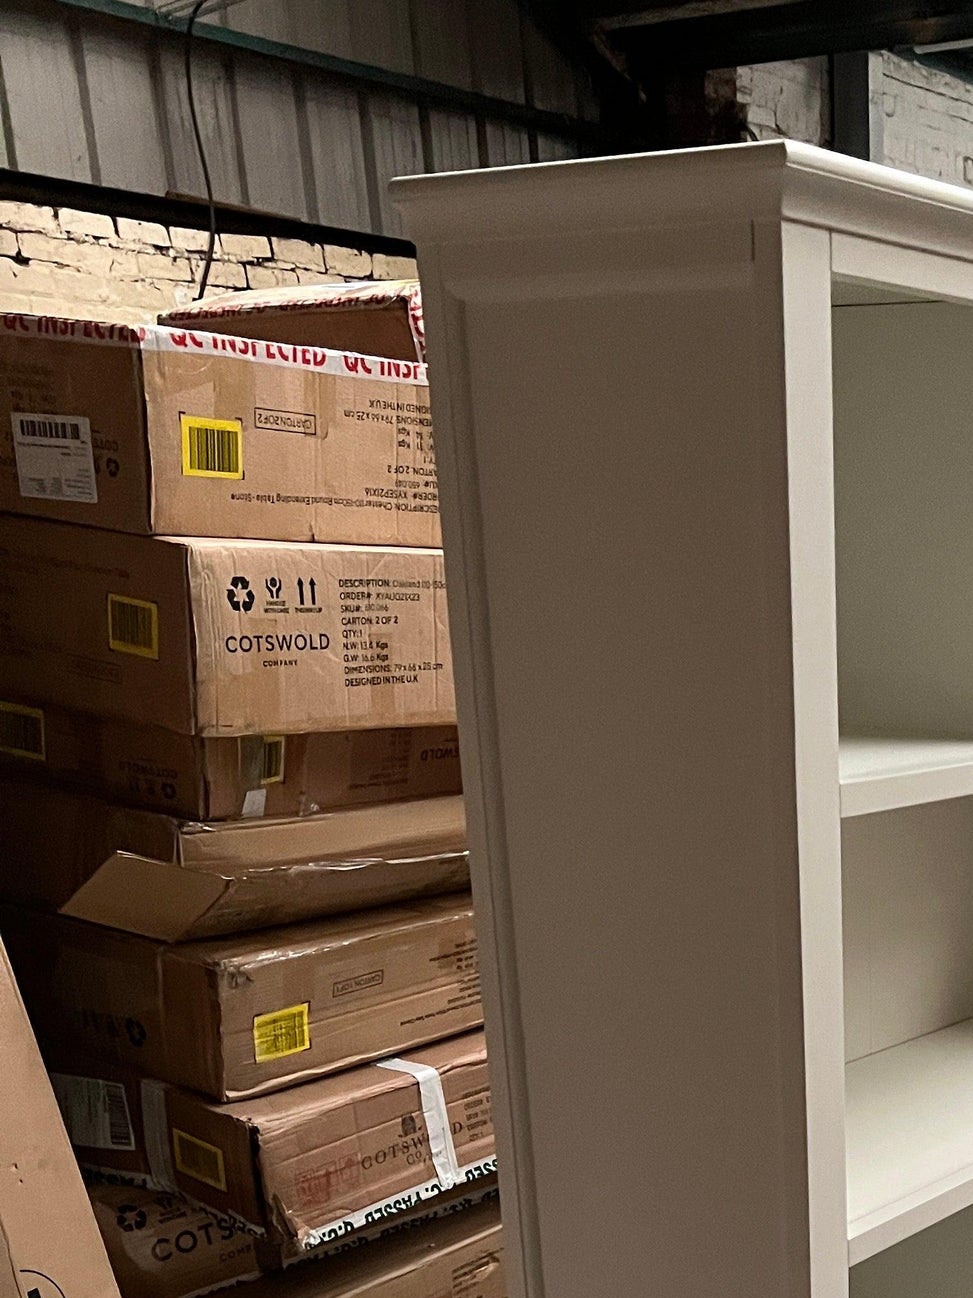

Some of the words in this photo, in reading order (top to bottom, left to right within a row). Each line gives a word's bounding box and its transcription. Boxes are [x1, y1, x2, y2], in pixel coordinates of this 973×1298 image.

[382, 616, 392, 624] OF
[226, 633, 330, 654] COTSWOLD
[263, 660, 298, 668] COMPANY
[361, 1122, 463, 1170] COTSWD
[152, 1221, 234, 1262] COTS
